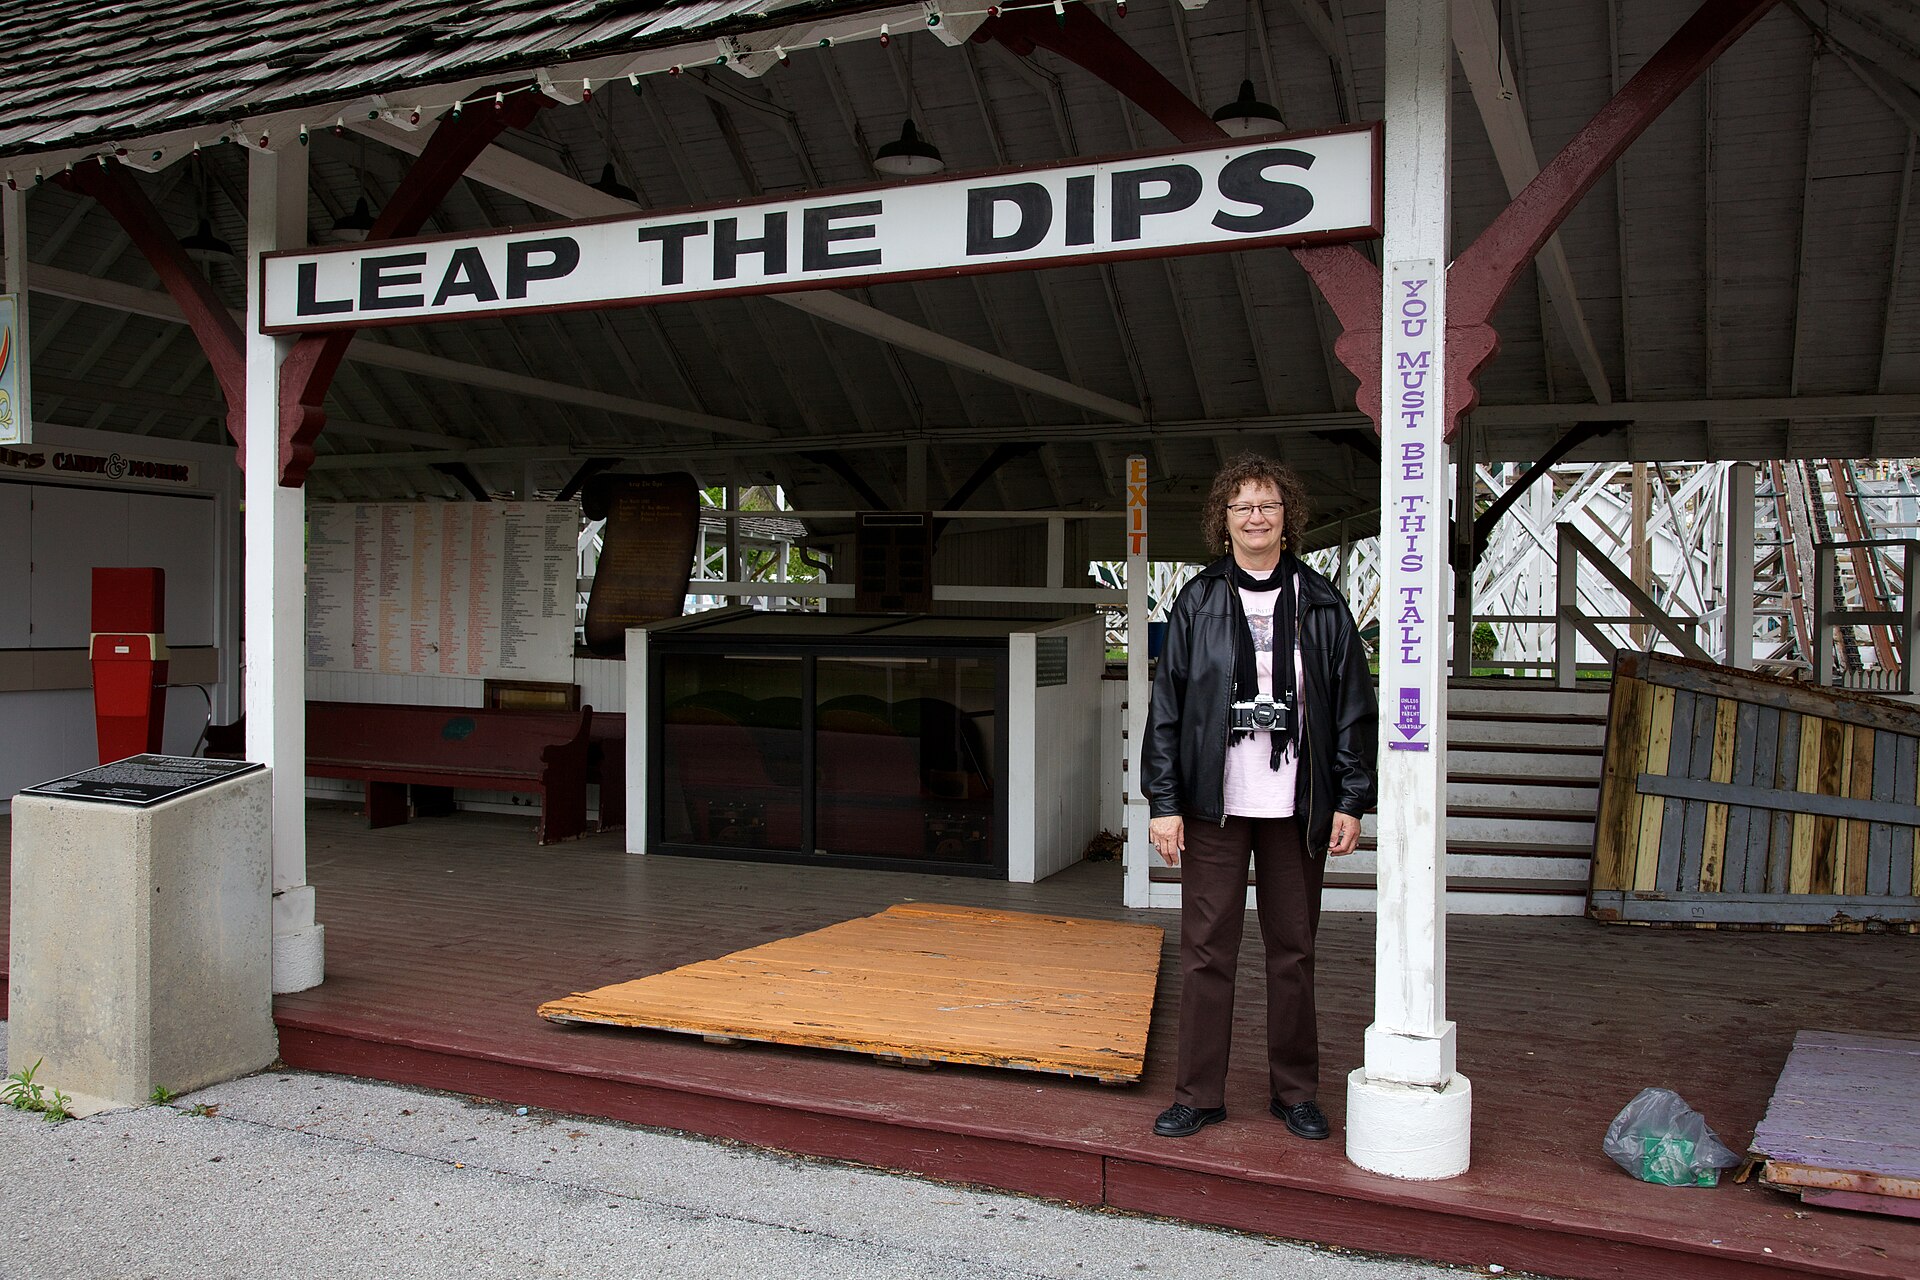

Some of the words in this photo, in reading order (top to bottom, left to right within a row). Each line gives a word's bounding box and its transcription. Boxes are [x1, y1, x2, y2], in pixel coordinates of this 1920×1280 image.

[296, 236, 581, 317] LEAP
[638, 200, 883, 287] THE
[966, 147, 1317, 257] DIPS
[1401, 279, 1428, 337] YOU
[1397, 350, 1431, 429] MUST
[53, 452, 107, 473] CANDY
[1400, 442, 1425, 480] BE
[1127, 460, 1147, 555] EXIT
[1399, 495, 1426, 573] THIS
[1397, 587, 1425, 664] TALL
